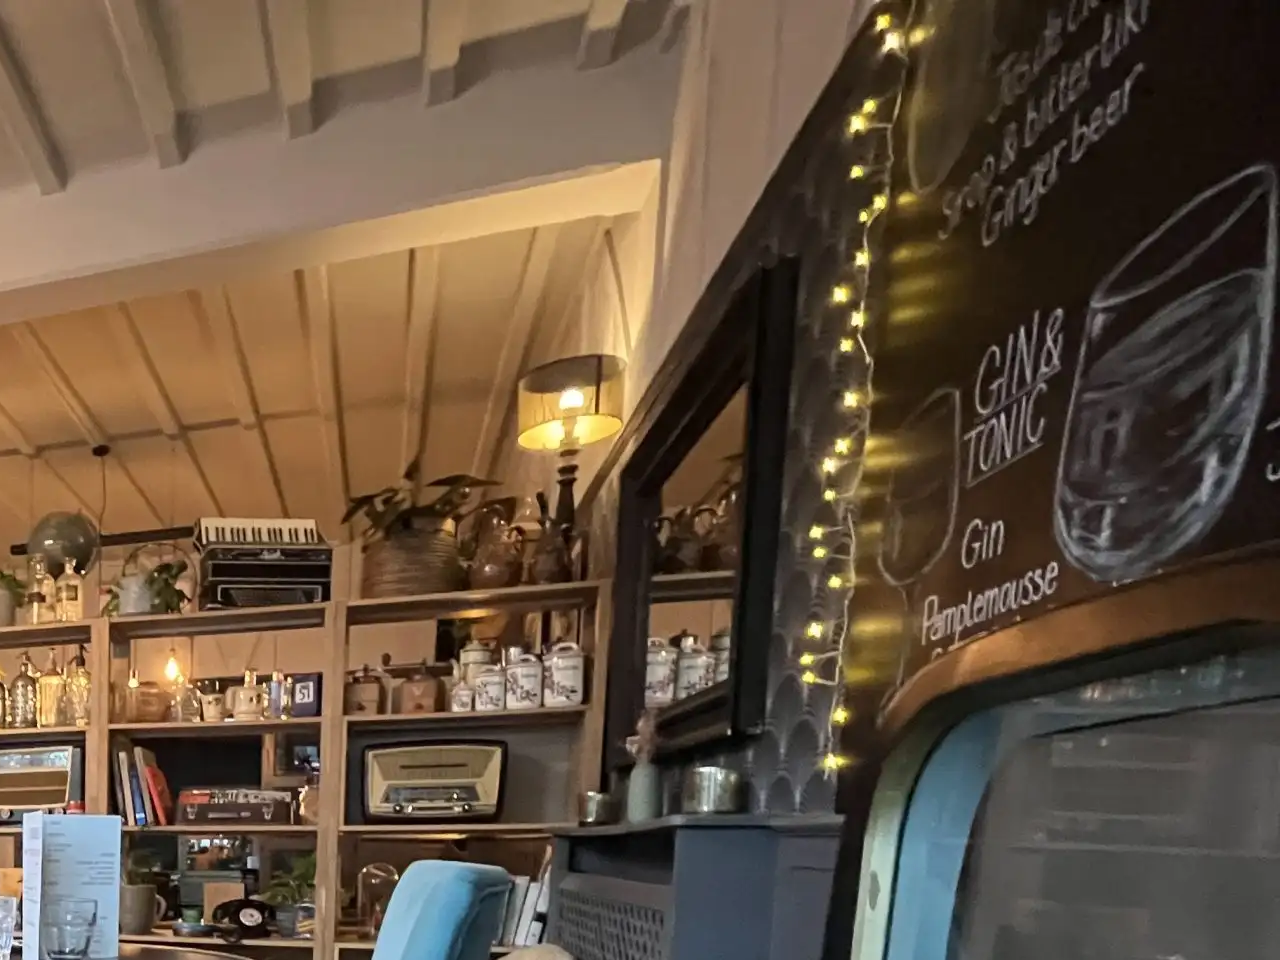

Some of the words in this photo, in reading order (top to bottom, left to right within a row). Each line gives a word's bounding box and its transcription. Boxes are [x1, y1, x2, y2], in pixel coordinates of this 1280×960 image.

[981, 138, 1068, 248] Ginger
[1069, 62, 1145, 164] beer
[963, 382, 1050, 487] TONIC
[960, 517, 1006, 569] Gin
[920, 560, 1060, 646] Pamplemousse
